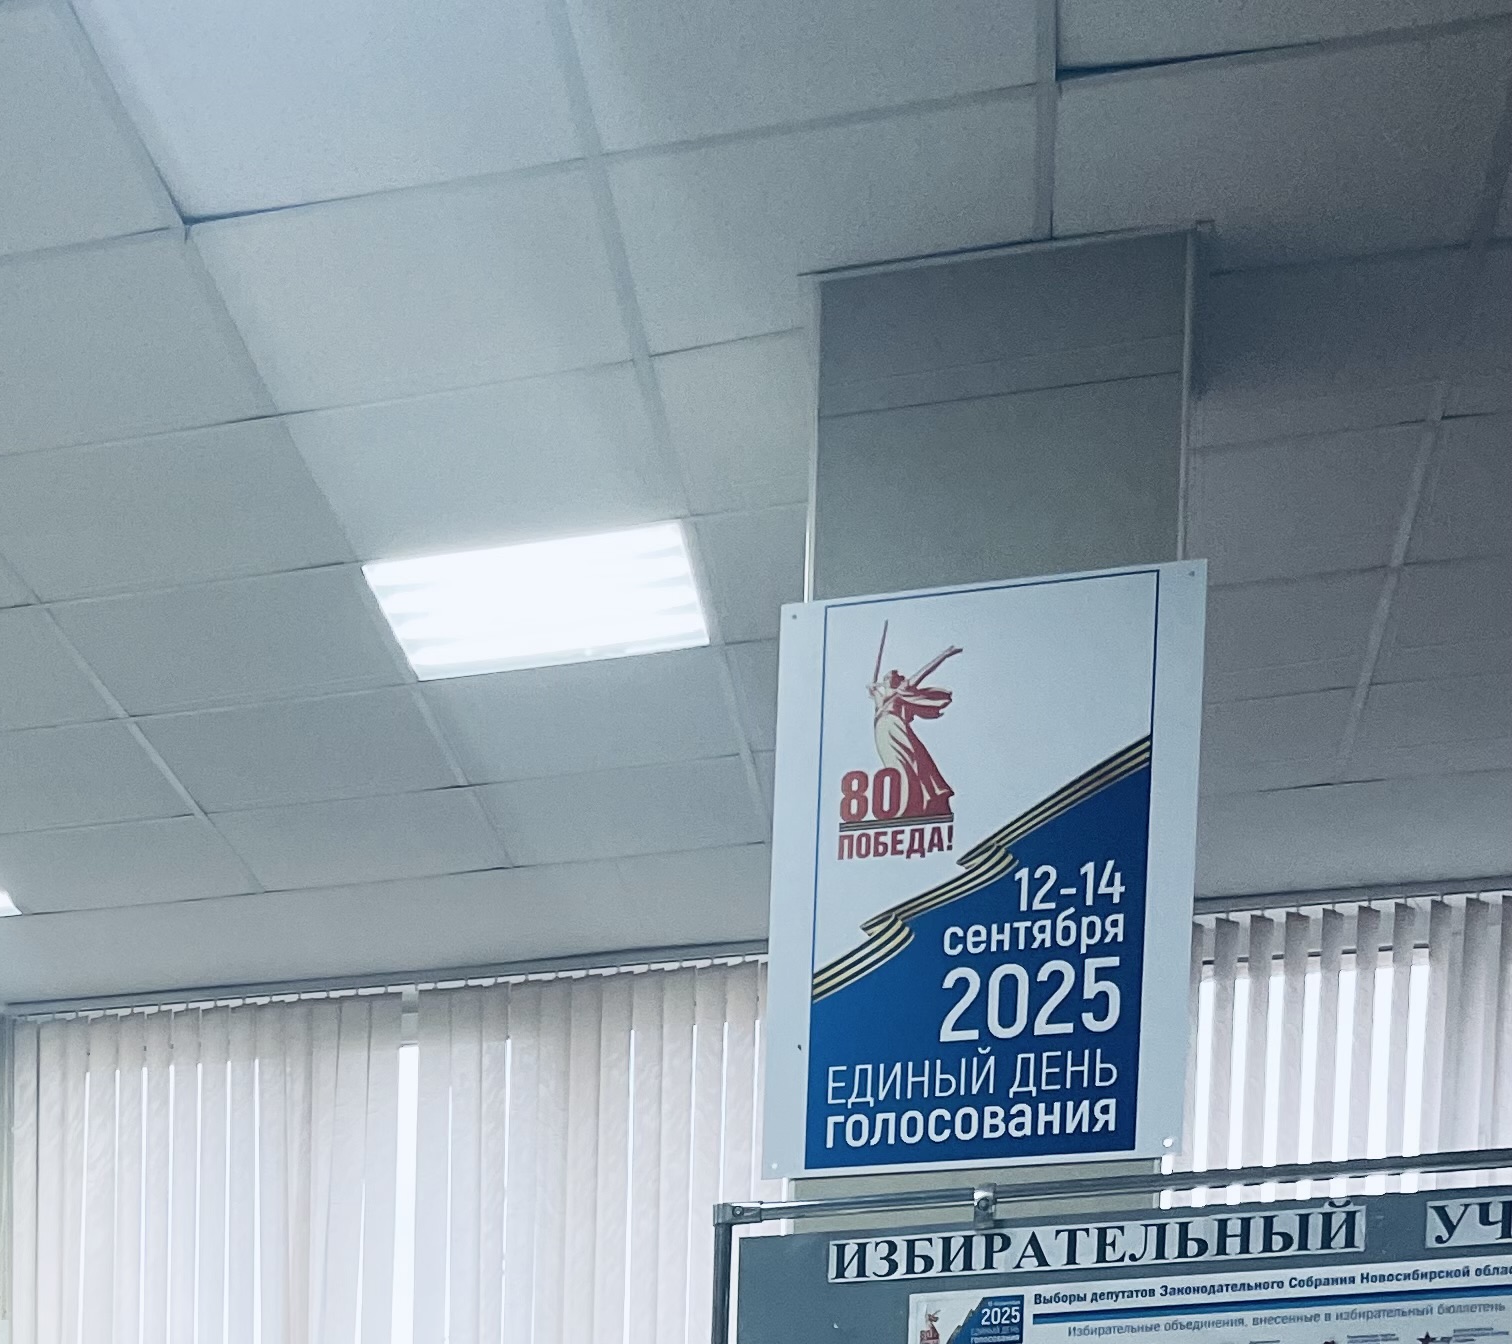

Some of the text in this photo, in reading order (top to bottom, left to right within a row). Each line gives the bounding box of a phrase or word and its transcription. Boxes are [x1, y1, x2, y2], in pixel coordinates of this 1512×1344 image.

[840, 767, 900, 824] 80
[837, 825, 954, 860] ПОБЕДА!
[1014, 860, 1125, 912] 12-14
[944, 912, 1124, 956] сентября
[939, 957, 1122, 1043] 2025
[827, 1045, 1118, 1108] ЕДИНЫЙ ДЕНЬ
[826, 1098, 1117, 1149] голосования
[831, 1200, 1360, 1282] ИЗБИРАТЕЛЬНЫЙ
[1034, 1291, 1088, 1306] Выборы
[1089, 1286, 1155, 1305] депутатов
[1159, 1278, 1285, 1299] Законодательного
[1288, 1273, 1356, 1291] Собрания
[1360, 1265, 1470, 1286] Новосибирской
[981, 1306, 1021, 1326] 2025
[1067, 1321, 1161, 1338] Избирательные
[1251, 1312, 1321, 1327] внесенные
[1324, 1312, 1332, 1322] в
[1335, 1304, 1434, 1323] избирательный
[1437, 1301, 1505, 1316] бюллетень
